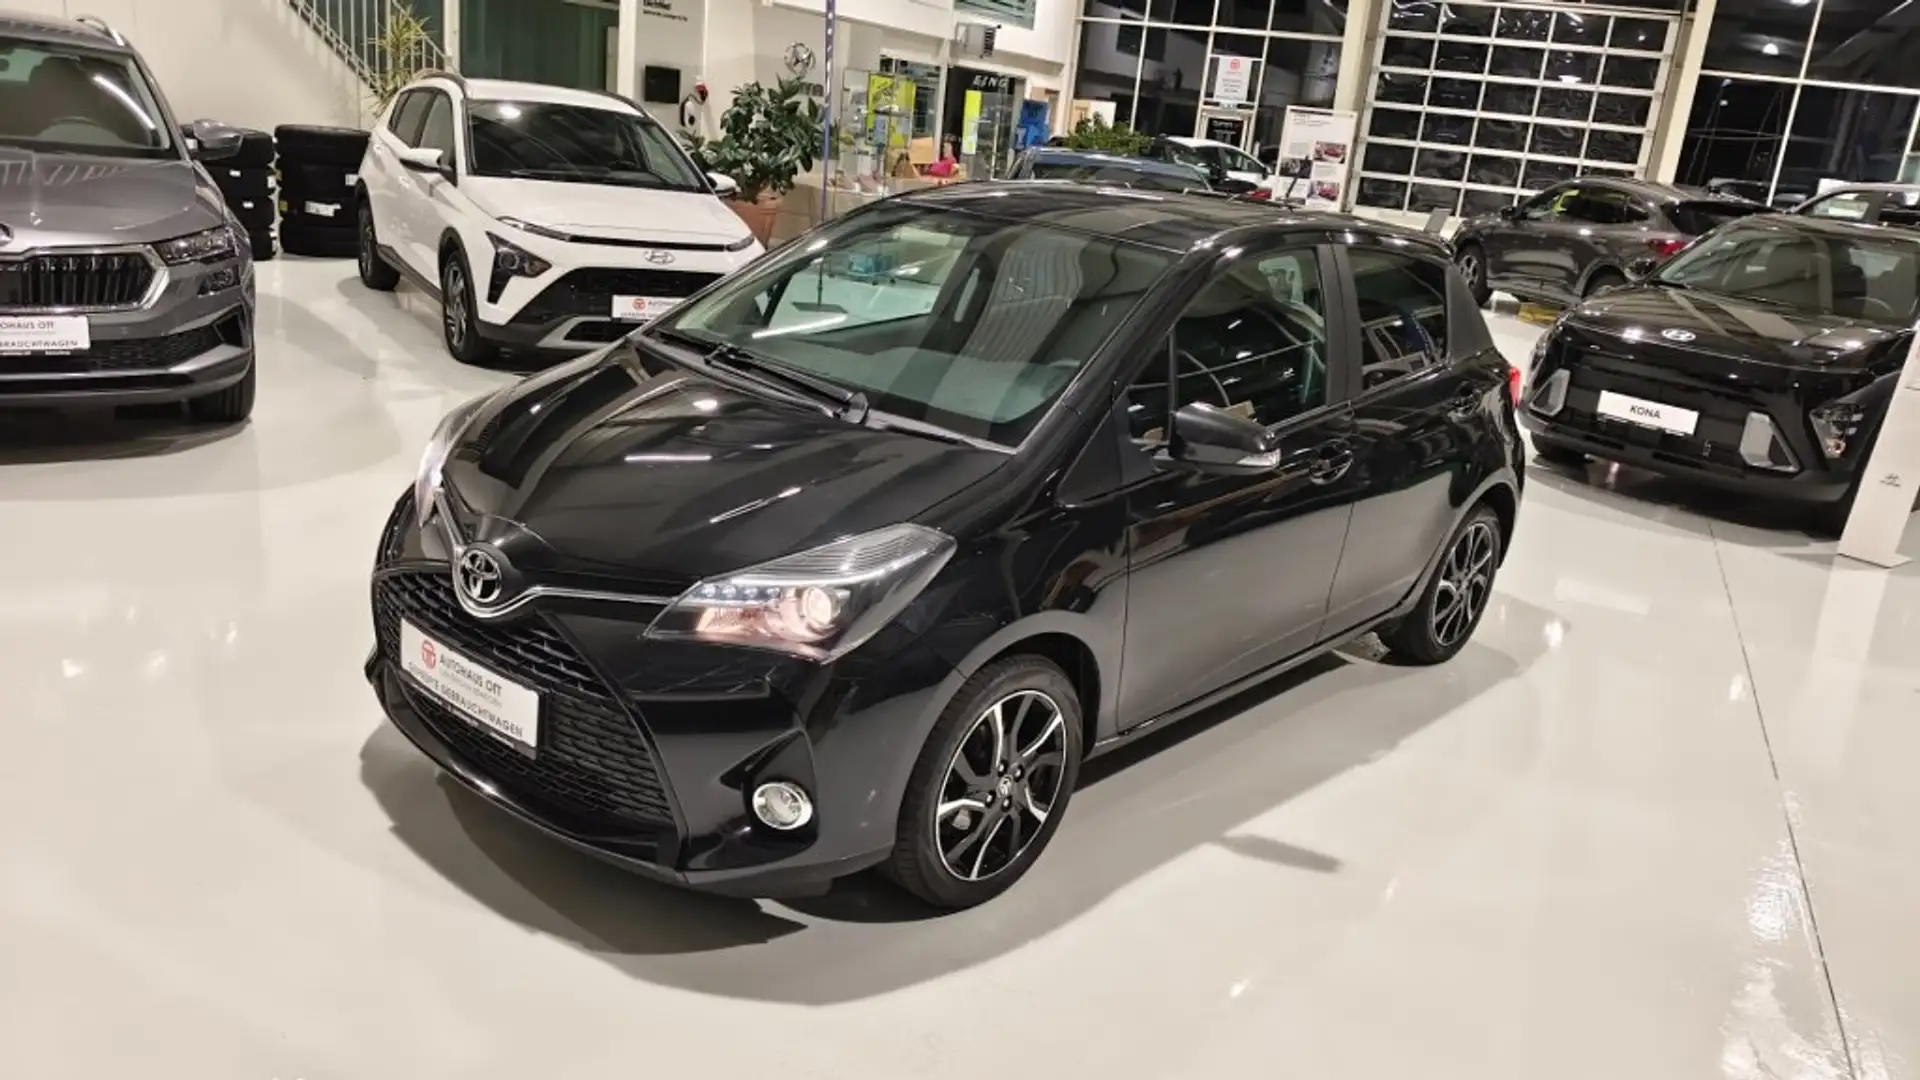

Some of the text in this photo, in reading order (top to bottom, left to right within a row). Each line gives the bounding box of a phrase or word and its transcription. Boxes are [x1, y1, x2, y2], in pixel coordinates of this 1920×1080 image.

[0, 321, 35, 329] OHAUS
[1629, 405, 1661, 419] KONA
[439, 653, 483, 687] AUTOHAUS
[485, 678, 502, 697] OTT
[440, 683, 523, 738] GEBRAUCHTWAGEN
